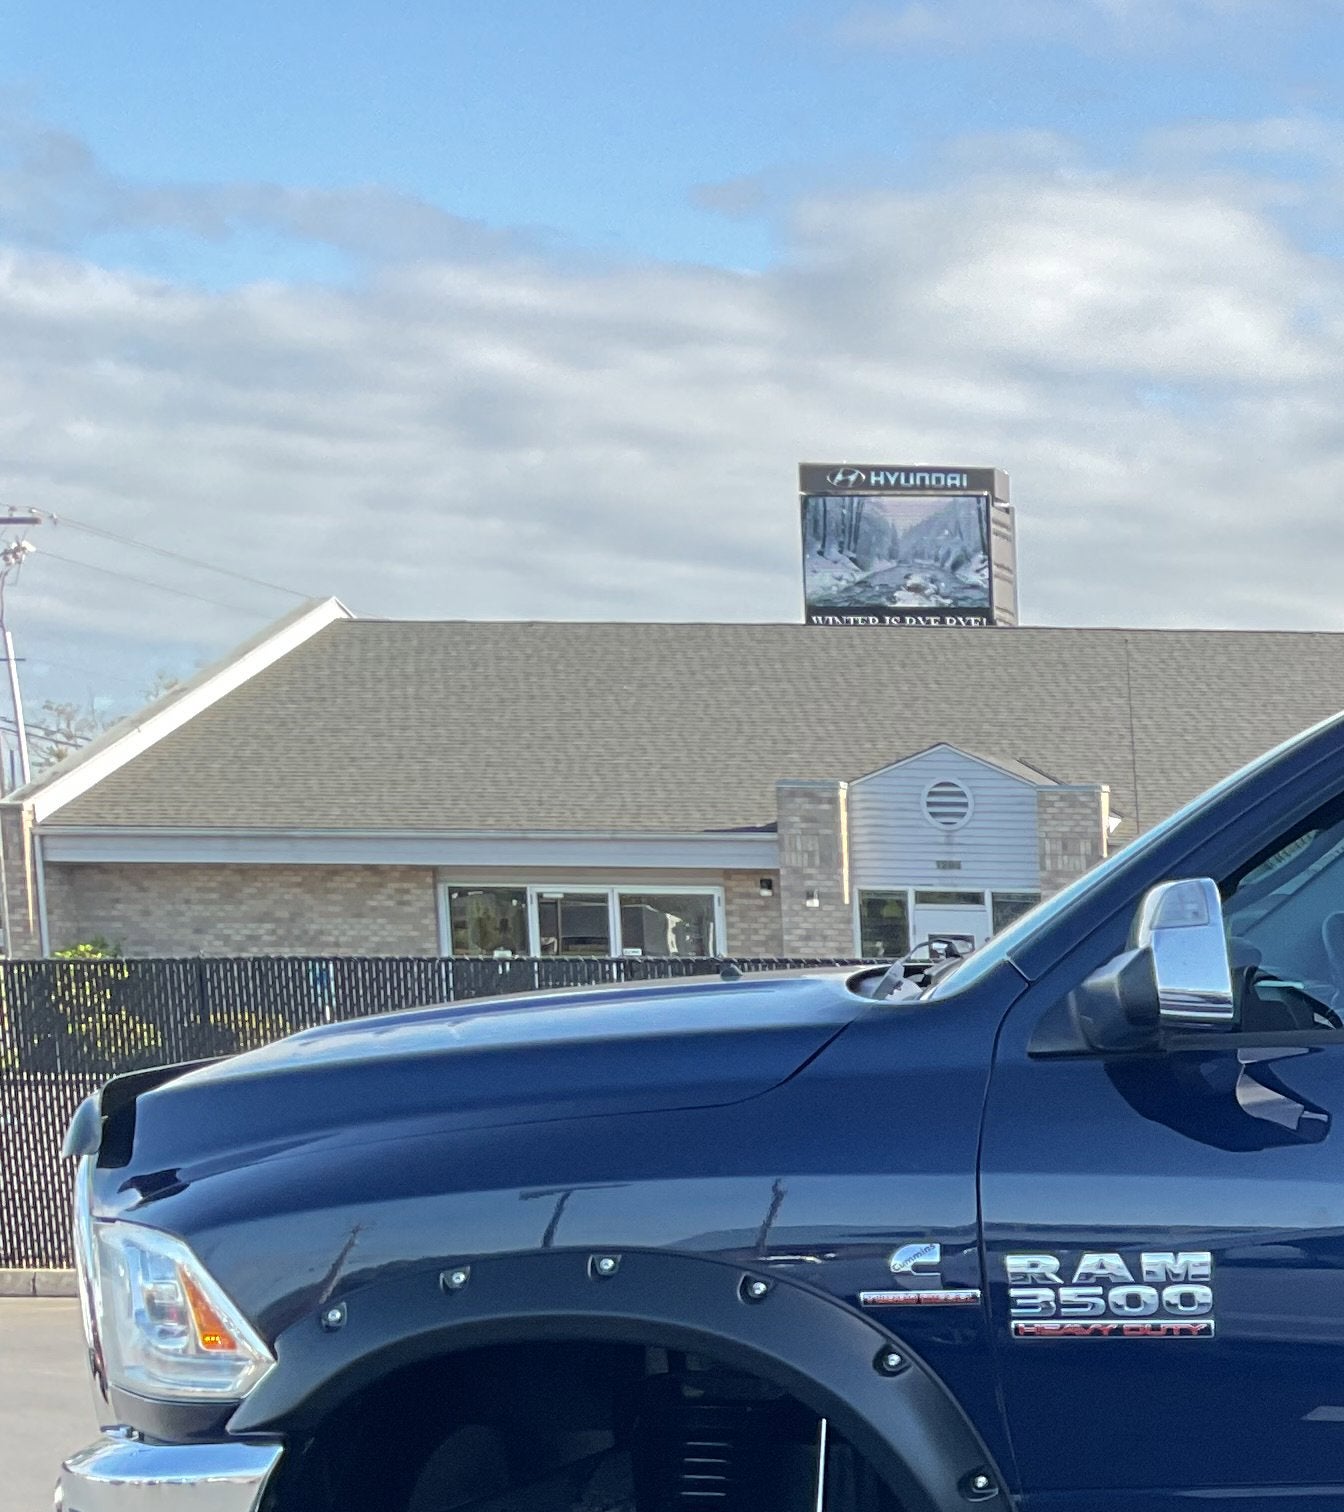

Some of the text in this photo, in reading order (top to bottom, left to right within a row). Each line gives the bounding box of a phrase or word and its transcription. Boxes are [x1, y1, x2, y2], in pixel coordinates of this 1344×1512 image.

[870, 471, 967, 488] HYUNDAI
[891, 1243, 938, 1272] Cummins
[1006, 1252, 1212, 1284] RAM
[1010, 1285, 1213, 1317] 3500
[1017, 1323, 1207, 1336] HEAVY DUTY
